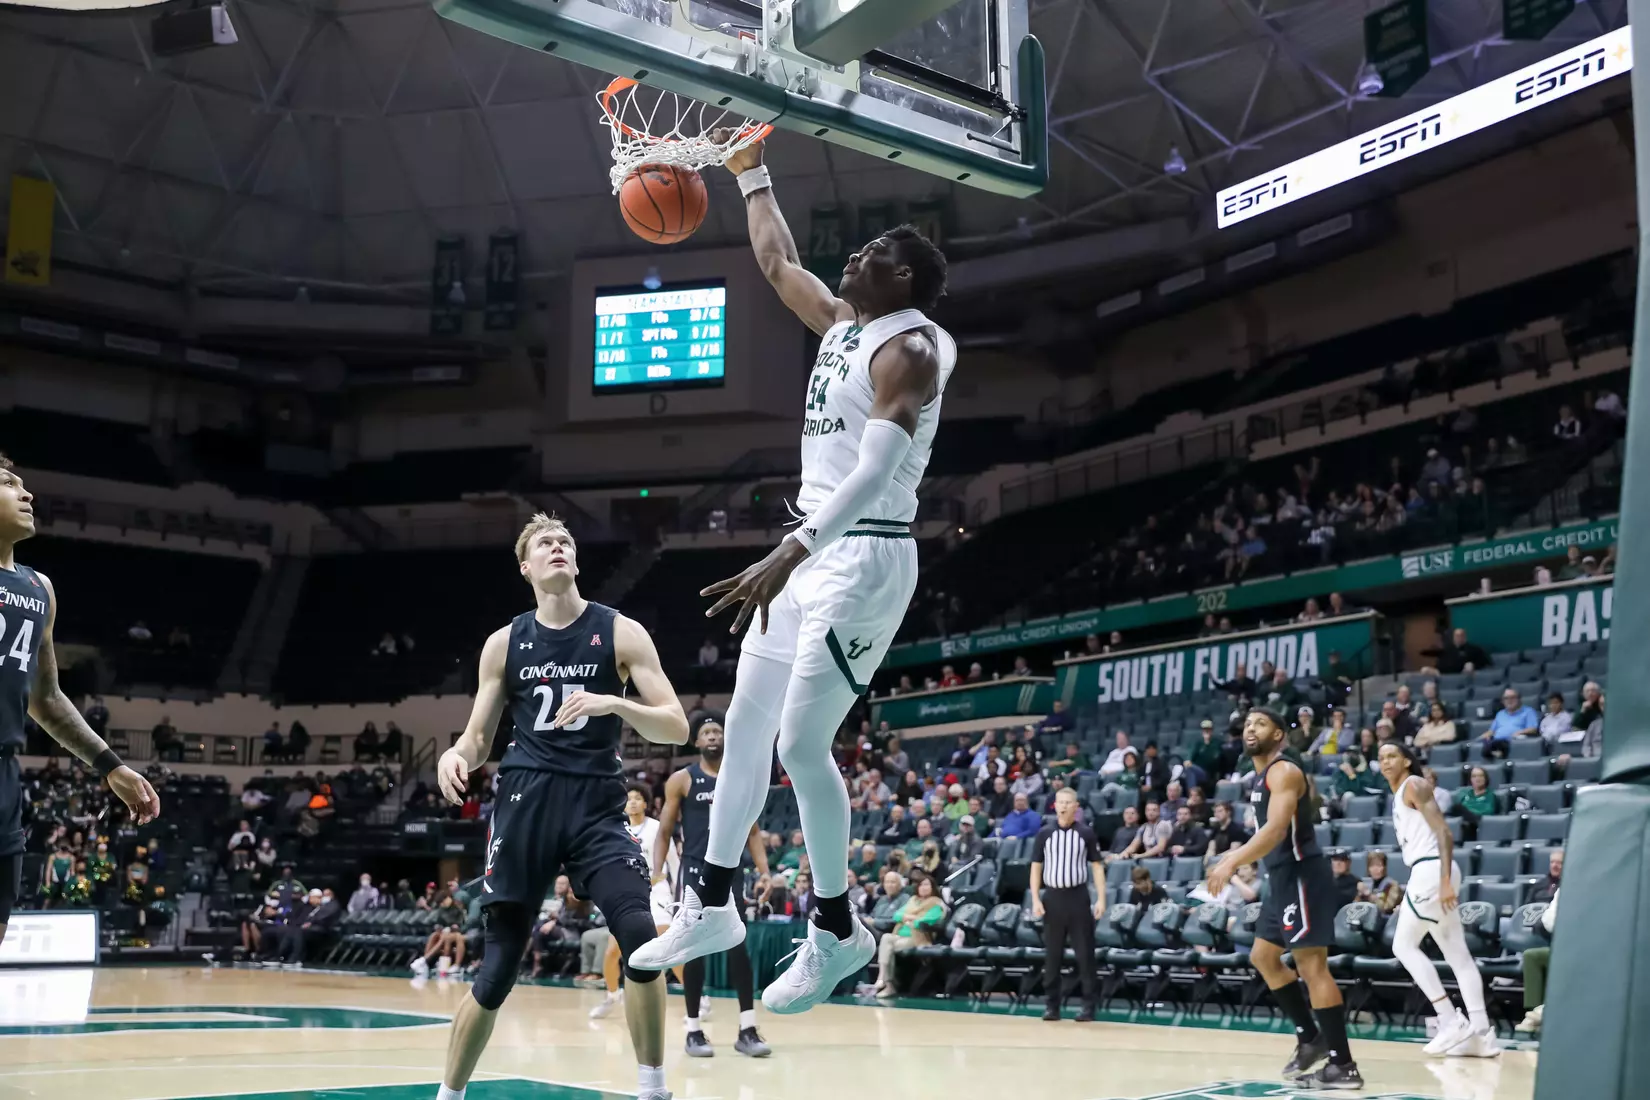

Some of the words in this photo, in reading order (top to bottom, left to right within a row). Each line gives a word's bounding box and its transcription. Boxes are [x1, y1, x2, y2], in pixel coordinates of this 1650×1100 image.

[1515, 48, 1605, 104] ESPN
[1359, 113, 1441, 165] ESPN
[1223, 175, 1287, 217] ESPN
[807, 374, 831, 412] 54
[803, 417, 846, 437] ORIDA
[1421, 552, 1453, 570] USF
[1464, 541, 1535, 563] FEDERAL
[1542, 526, 1607, 550] CREDIT
[0, 587, 45, 614] CINNATI
[1197, 591, 1228, 612] 202
[976, 633, 1019, 648] FEDERAL
[1021, 625, 1057, 641] CREDIT
[519, 661, 599, 681] CINCINNATI
[1098, 651, 1185, 704] SOUTH
[1193, 631, 1319, 692] FLORIDA
